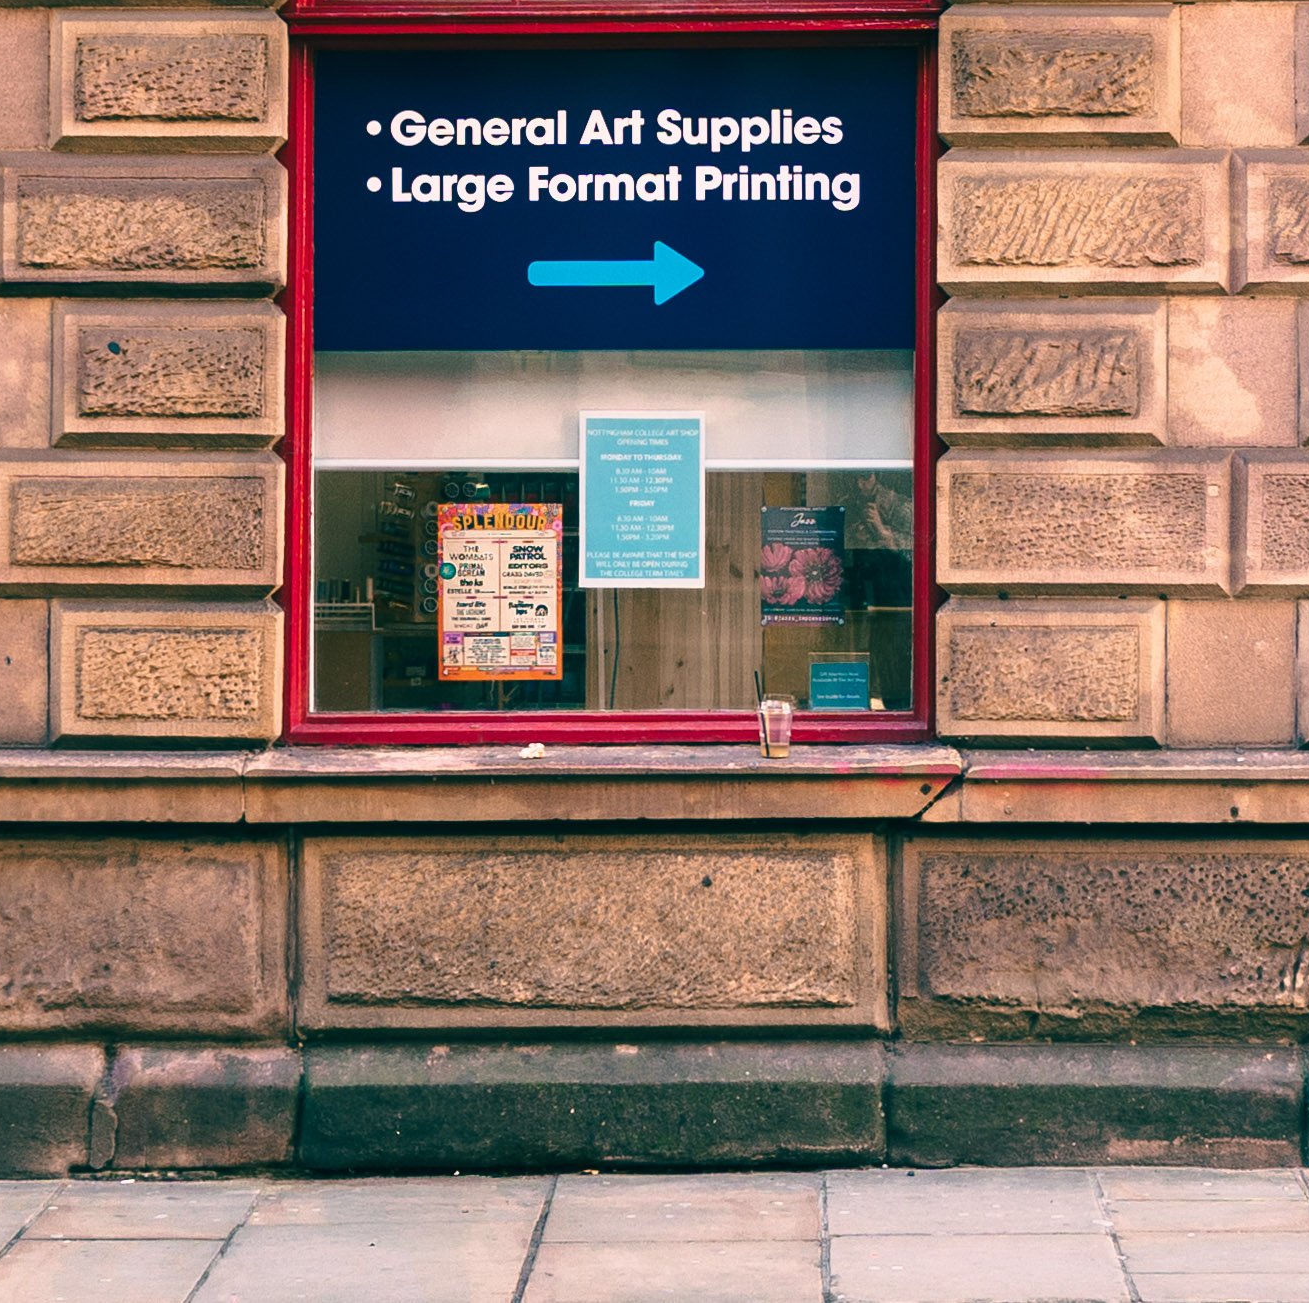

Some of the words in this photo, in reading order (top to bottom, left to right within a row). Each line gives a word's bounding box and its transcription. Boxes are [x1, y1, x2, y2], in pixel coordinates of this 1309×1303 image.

[390, 108, 567, 147] General
[579, 108, 644, 146] Art
[655, 107, 844, 153] Supplies
[390, 165, 515, 213] Large
[528, 165, 682, 203] Format
[695, 164, 861, 212] Printing
[451, 513, 548, 531] SPLENDOUR
[512, 545, 544, 553] SNOW
